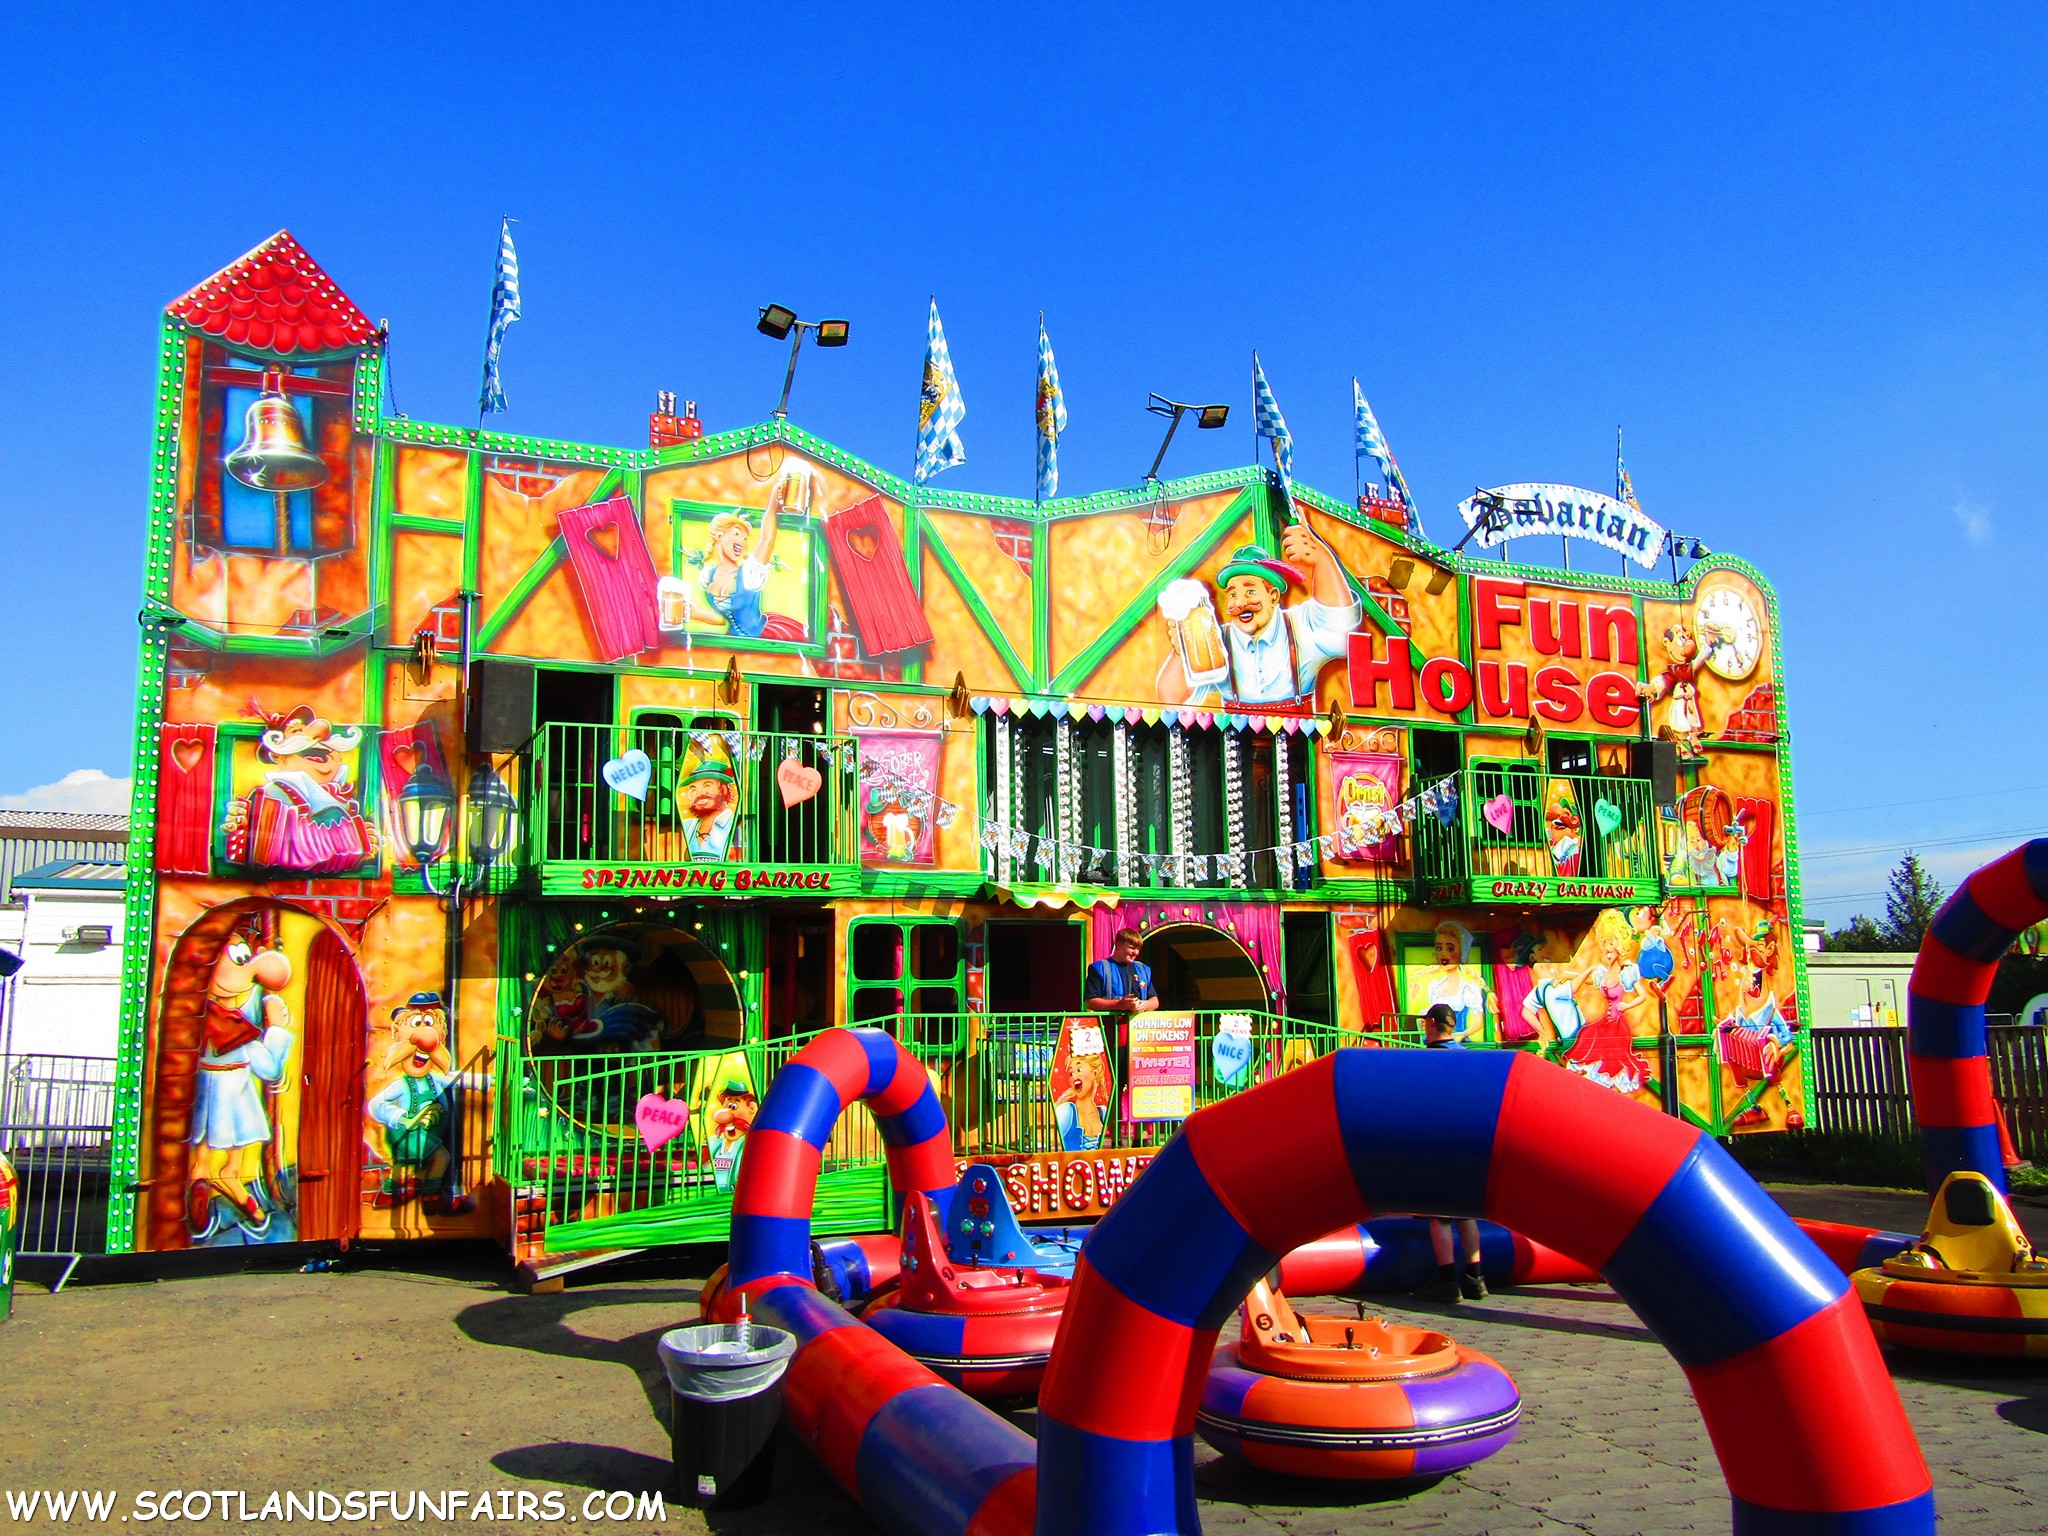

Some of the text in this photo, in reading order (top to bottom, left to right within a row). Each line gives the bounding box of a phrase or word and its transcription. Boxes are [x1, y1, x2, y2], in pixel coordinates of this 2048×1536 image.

[1471, 493, 1650, 551] Bavarian
[1474, 575, 1638, 666] Fun
[1347, 630, 1640, 728] House
[611, 761, 646, 784] HELLO
[783, 769, 814, 791] PEACE
[1490, 803, 1509, 821] LOVE
[1597, 805, 1620, 823] PEACE
[581, 868, 832, 890] SPINNING BARREL
[1492, 880, 1635, 899] CRAZY CAR WASH
[1132, 1017, 1192, 1029] RUNNING LOW
[1084, 1031, 1092, 1043] 2
[1135, 1030, 1190, 1041] ON TOKENS?
[1077, 1044, 1101, 1052] TOKENS
[1217, 1042, 1244, 1060] NICE
[1132, 1056, 1191, 1069] TWISTER
[642, 1106, 683, 1126] PEACE
[1005, 1155, 1155, 1213] SHOW
[1259, 1315, 1271, 1329] 5
